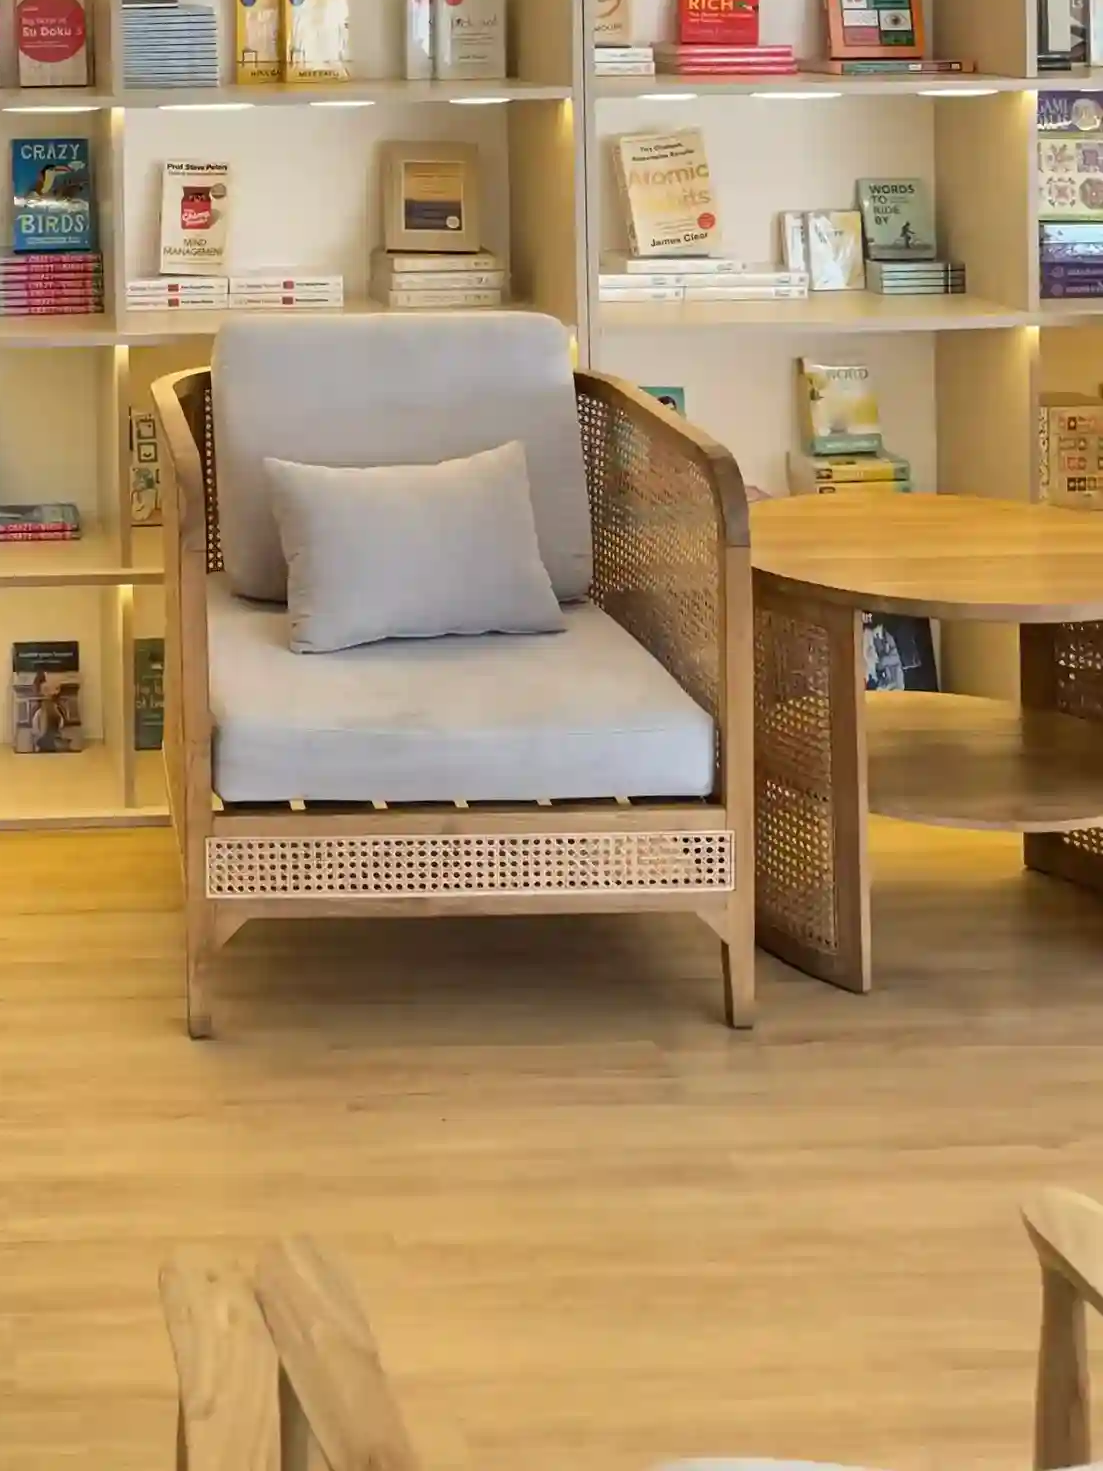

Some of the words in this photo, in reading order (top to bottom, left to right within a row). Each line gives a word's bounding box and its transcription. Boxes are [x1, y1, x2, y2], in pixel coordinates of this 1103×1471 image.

[22, 27, 37, 37] Su
[40, 26, 71, 37] Doku
[21, 144, 80, 160] CRAZY
[869, 184, 915, 194] WORDS
[872, 195, 887, 204] TO
[16, 214, 84, 234] BIRDS
[875, 216, 889, 225] BY
[183, 239, 207, 247] MIND
[650, 236, 681, 247] James
[163, 247, 223, 256] MANAGEMENT
